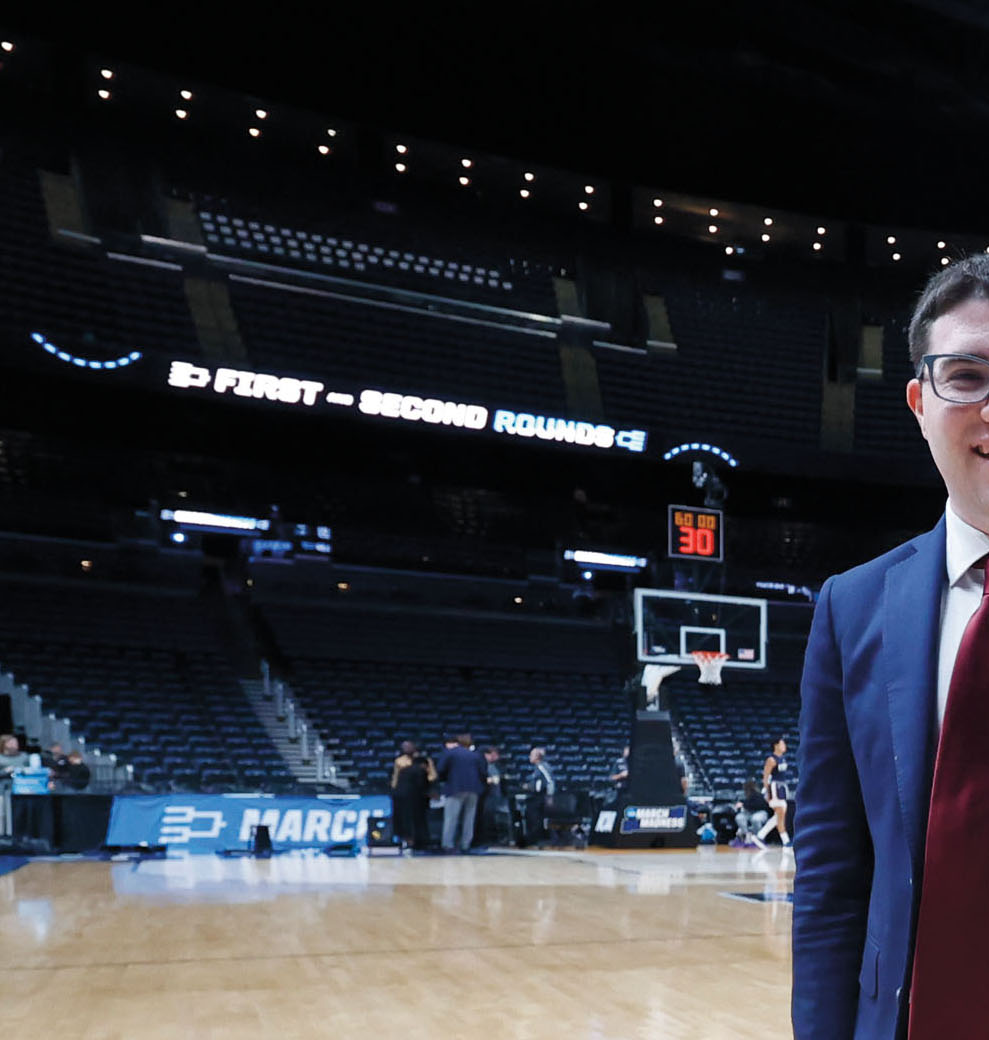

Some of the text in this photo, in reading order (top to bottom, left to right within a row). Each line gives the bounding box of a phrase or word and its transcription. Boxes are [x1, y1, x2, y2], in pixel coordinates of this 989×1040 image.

[214, 369, 614, 447] FIRST SECOND ROUNDS
[680, 526, 714, 555] 30
